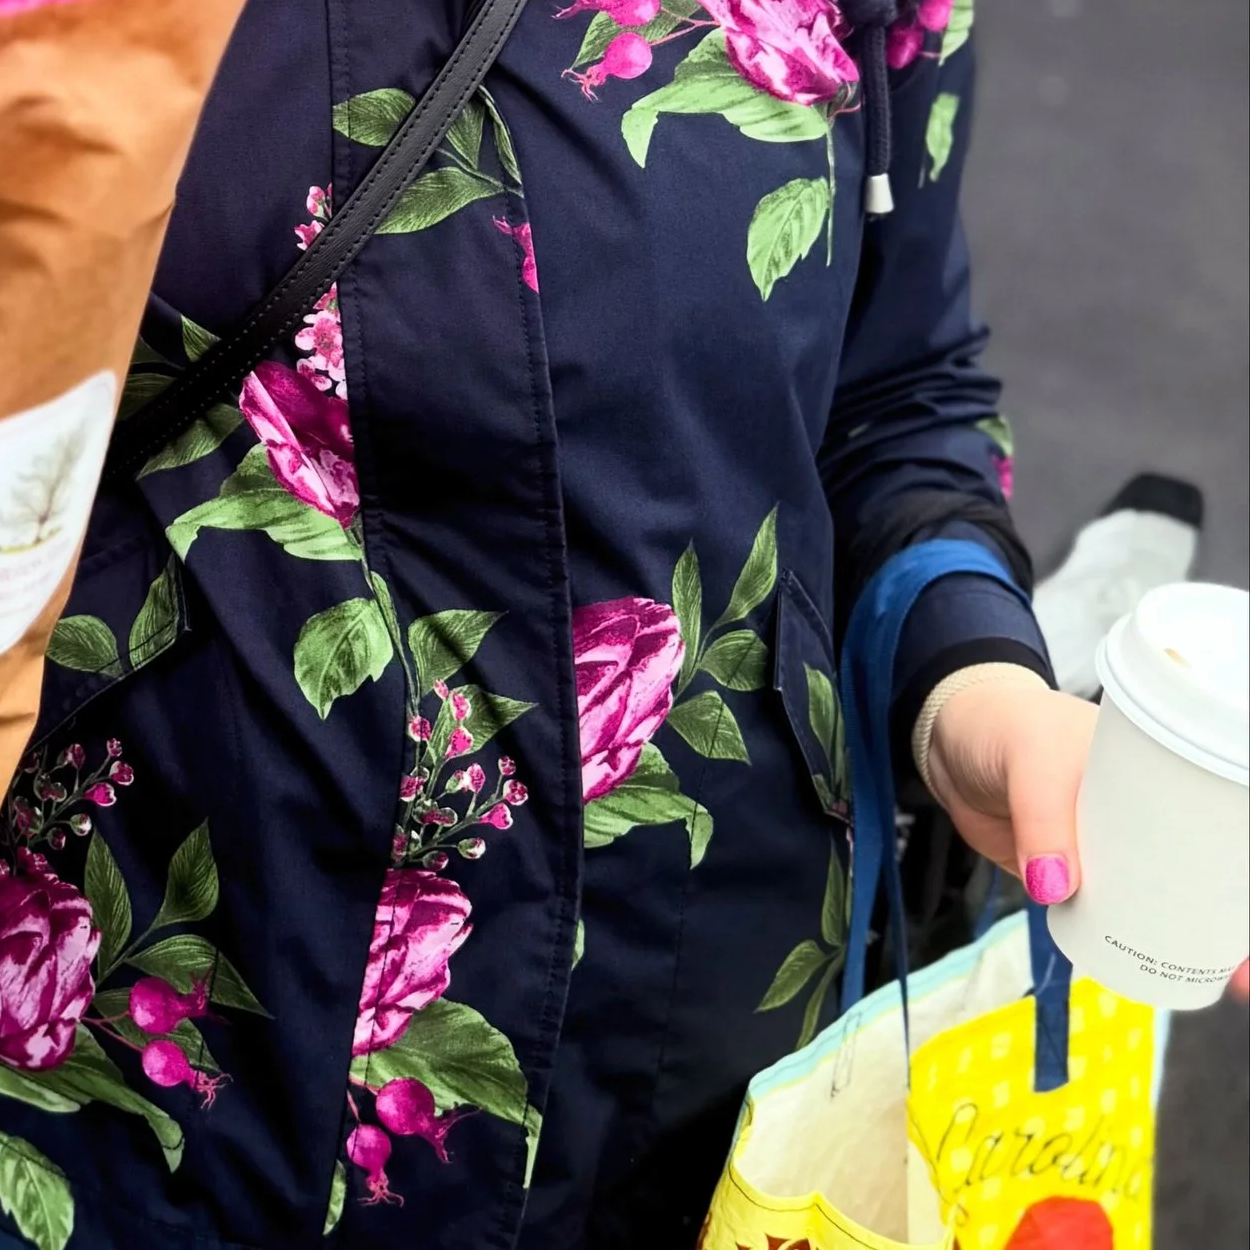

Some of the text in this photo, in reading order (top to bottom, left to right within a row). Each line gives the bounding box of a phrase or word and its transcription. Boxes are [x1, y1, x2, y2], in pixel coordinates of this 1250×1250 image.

[1104, 935, 1158, 966] CAUTION:
[1161, 961, 1216, 975] CONTENTS
[1139, 964, 1157, 975] DO
[1159, 971, 1183, 982] NOT
